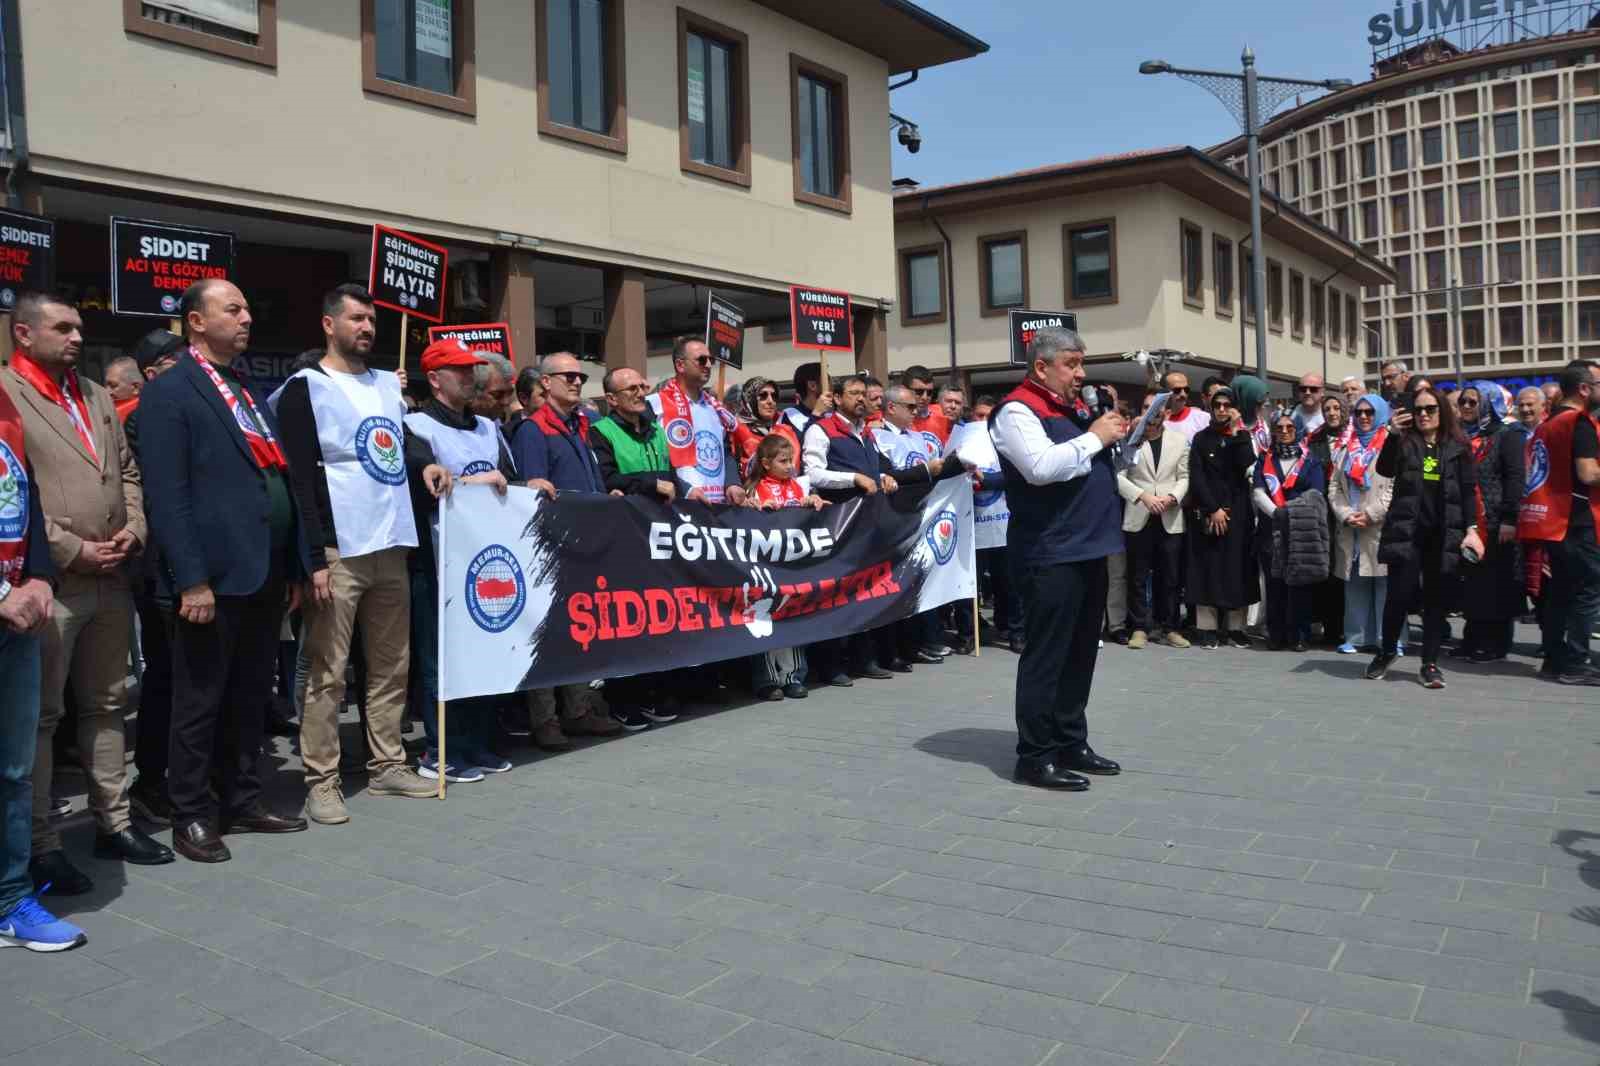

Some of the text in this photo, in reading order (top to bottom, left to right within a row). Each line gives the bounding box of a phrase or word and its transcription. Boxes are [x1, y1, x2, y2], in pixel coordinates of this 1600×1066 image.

[1368, 0, 1568, 46] SÜME
[1, 226, 50, 248] ŞİDDETE
[140, 236, 210, 261] ŞİDDET
[385, 237, 439, 265] EĞİTİMCİYE
[125, 258, 149, 272] ACI
[152, 260, 169, 274] VE
[386, 251, 436, 279] ŞİDDETE
[153, 275, 193, 289] DEME
[384, 267, 435, 300] HAYIR
[800, 303, 845, 319] YANGIN
[812, 319, 836, 332] YERİ
[1021, 318, 1063, 331] OKULDA
[649, 513, 834, 562] EĞİTİMDE
